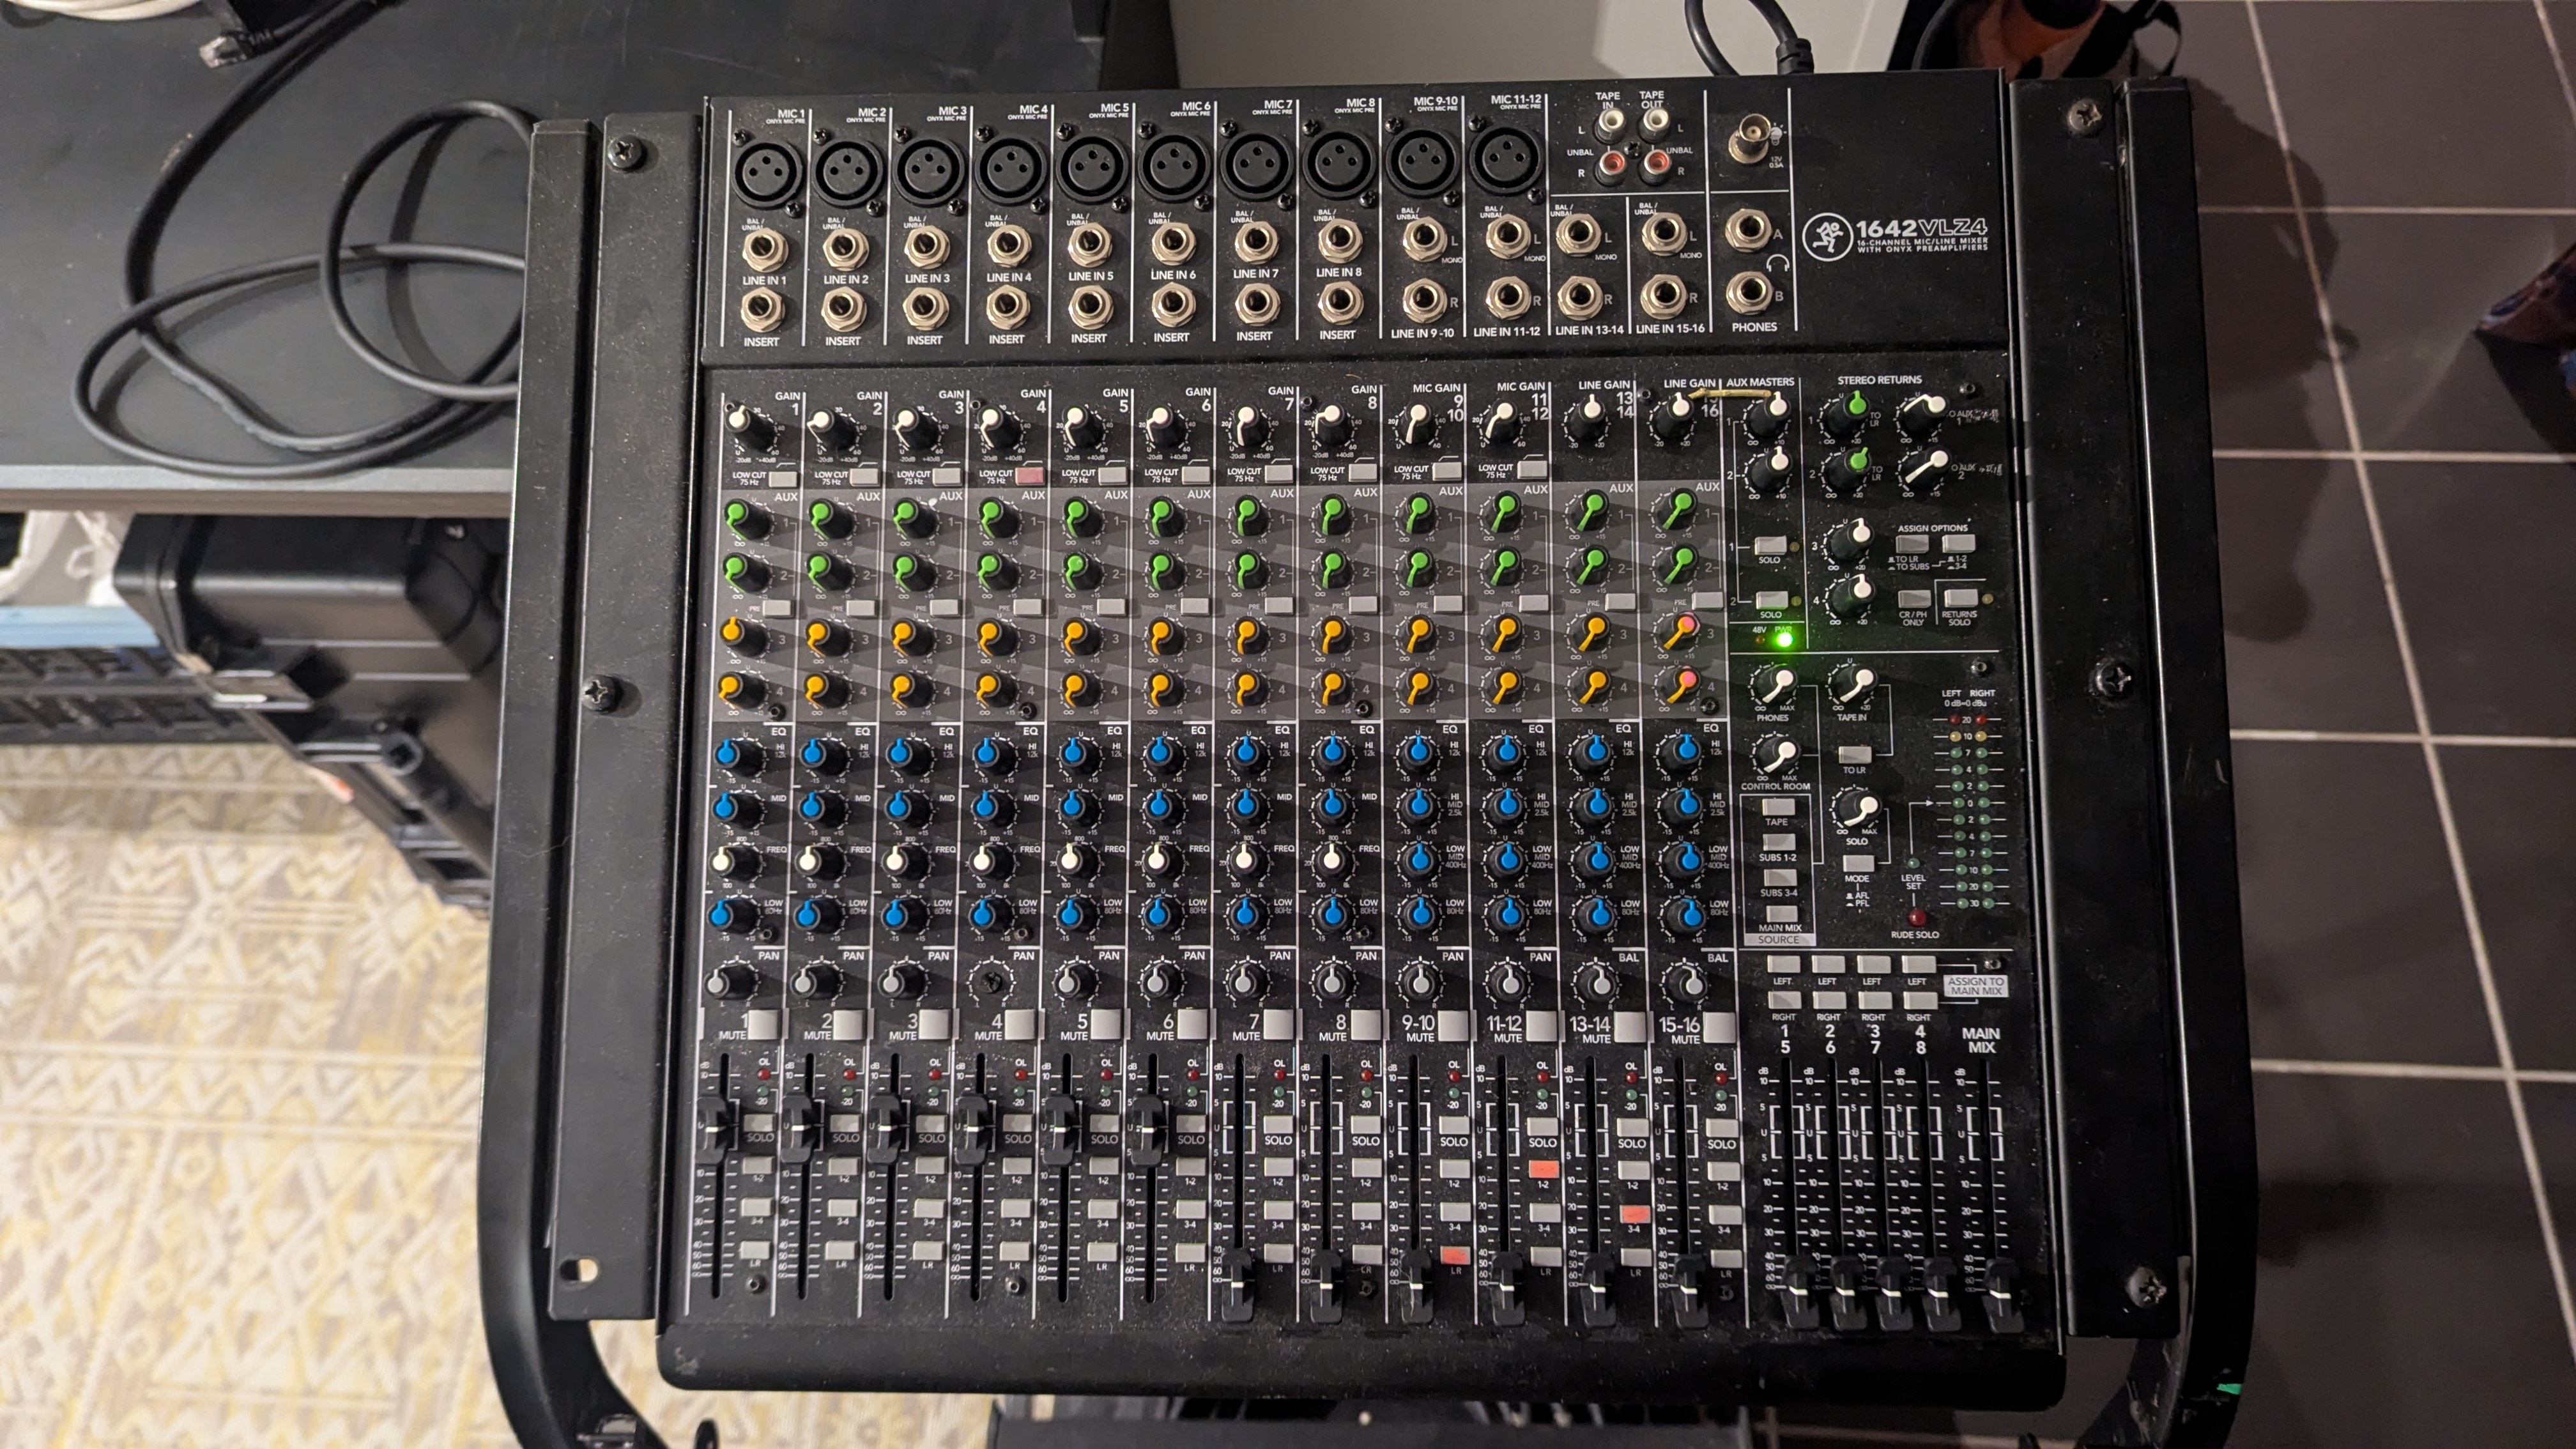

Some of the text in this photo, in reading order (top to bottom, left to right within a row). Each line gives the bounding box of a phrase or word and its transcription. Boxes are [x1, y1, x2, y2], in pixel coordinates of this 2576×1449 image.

[1492, 95, 1541, 103] MIC 11-12
[1639, 91, 1664, 99] TAPE
[1264, 100, 1292, 109] MIC 7
[1347, 98, 1375, 107] MIC 8
[1414, 96, 1458, 105] MIC 9-10
[859, 108, 886, 116] MIC 2
[939, 106, 967, 115] MIC 3
[1020, 105, 1048, 114] MIC 4
[1101, 103, 1129, 112] MIC 5
[778, 109, 804, 118] MIC 1
[1858, 244, 1881, 253] WITH
[1069, 272, 1114, 280] LINE IN 5
[1317, 268, 1361, 277] LINE IN 8
[743, 276, 786, 285] LINE IN 1
[1474, 326, 1540, 337] LINE IN 11-12
[1636, 324, 1705, 334] LINE IN 15-16
[1733, 322, 1777, 332] PHONES
[1320, 330, 1356, 339] INSERT
[744, 337, 779, 346] INSERT
[1579, 380, 1630, 389] LINE GAIN
[1726, 378, 1795, 387] AUX MASTERS
[1838, 376, 1922, 385] STEREO RETURNS
[1186, 388, 1211, 396] GAIN
[1413, 384, 1460, 392] MIC GAIN
[775, 392, 801, 400] GAIN
[1617, 392, 1633, 404] 13
[1202, 399, 1211, 411] 6
[1454, 395, 1463, 408] 9
[792, 403, 798, 415] 1
[1617, 406, 1634, 418] 14
[1447, 409, 1464, 422] 10
[1524, 485, 1548, 494] AUX
[774, 493, 797, 501] AUX
[1759, 935, 1799, 944] SOURCE
[759, 951, 779, 960] PAN
[1708, 954, 1728, 962] BAL
[1949, 977, 2004, 986] ASSIGN TO
[822, 1013, 832, 1029] 2
[1337, 1015, 1346, 1030] 8
[1402, 1015, 1435, 1031] 9-10
[1487, 1016, 1522, 1031] 11-12
[1570, 1016, 1611, 1032] 13-14
[1660, 1017, 1700, 1033] 15-16
[719, 1031, 746, 1039] MUTE
[1781, 1024, 1788, 1037] 1
[1915, 1025, 1926, 1038] 4
[1963, 1028, 2000, 1039] MAIN
[975, 1031, 1002, 1040] MUTE
[1583, 1034, 1611, 1043] MUTE
[1781, 1040, 1790, 1054] 5
[1917, 1041, 1926, 1054] 8
[1969, 1041, 1996, 1053] MIX
[833, 1133, 860, 1142] SOLO
[1265, 1135, 1292, 1145] SOLO
[1708, 1140, 1736, 1149] SOLO
